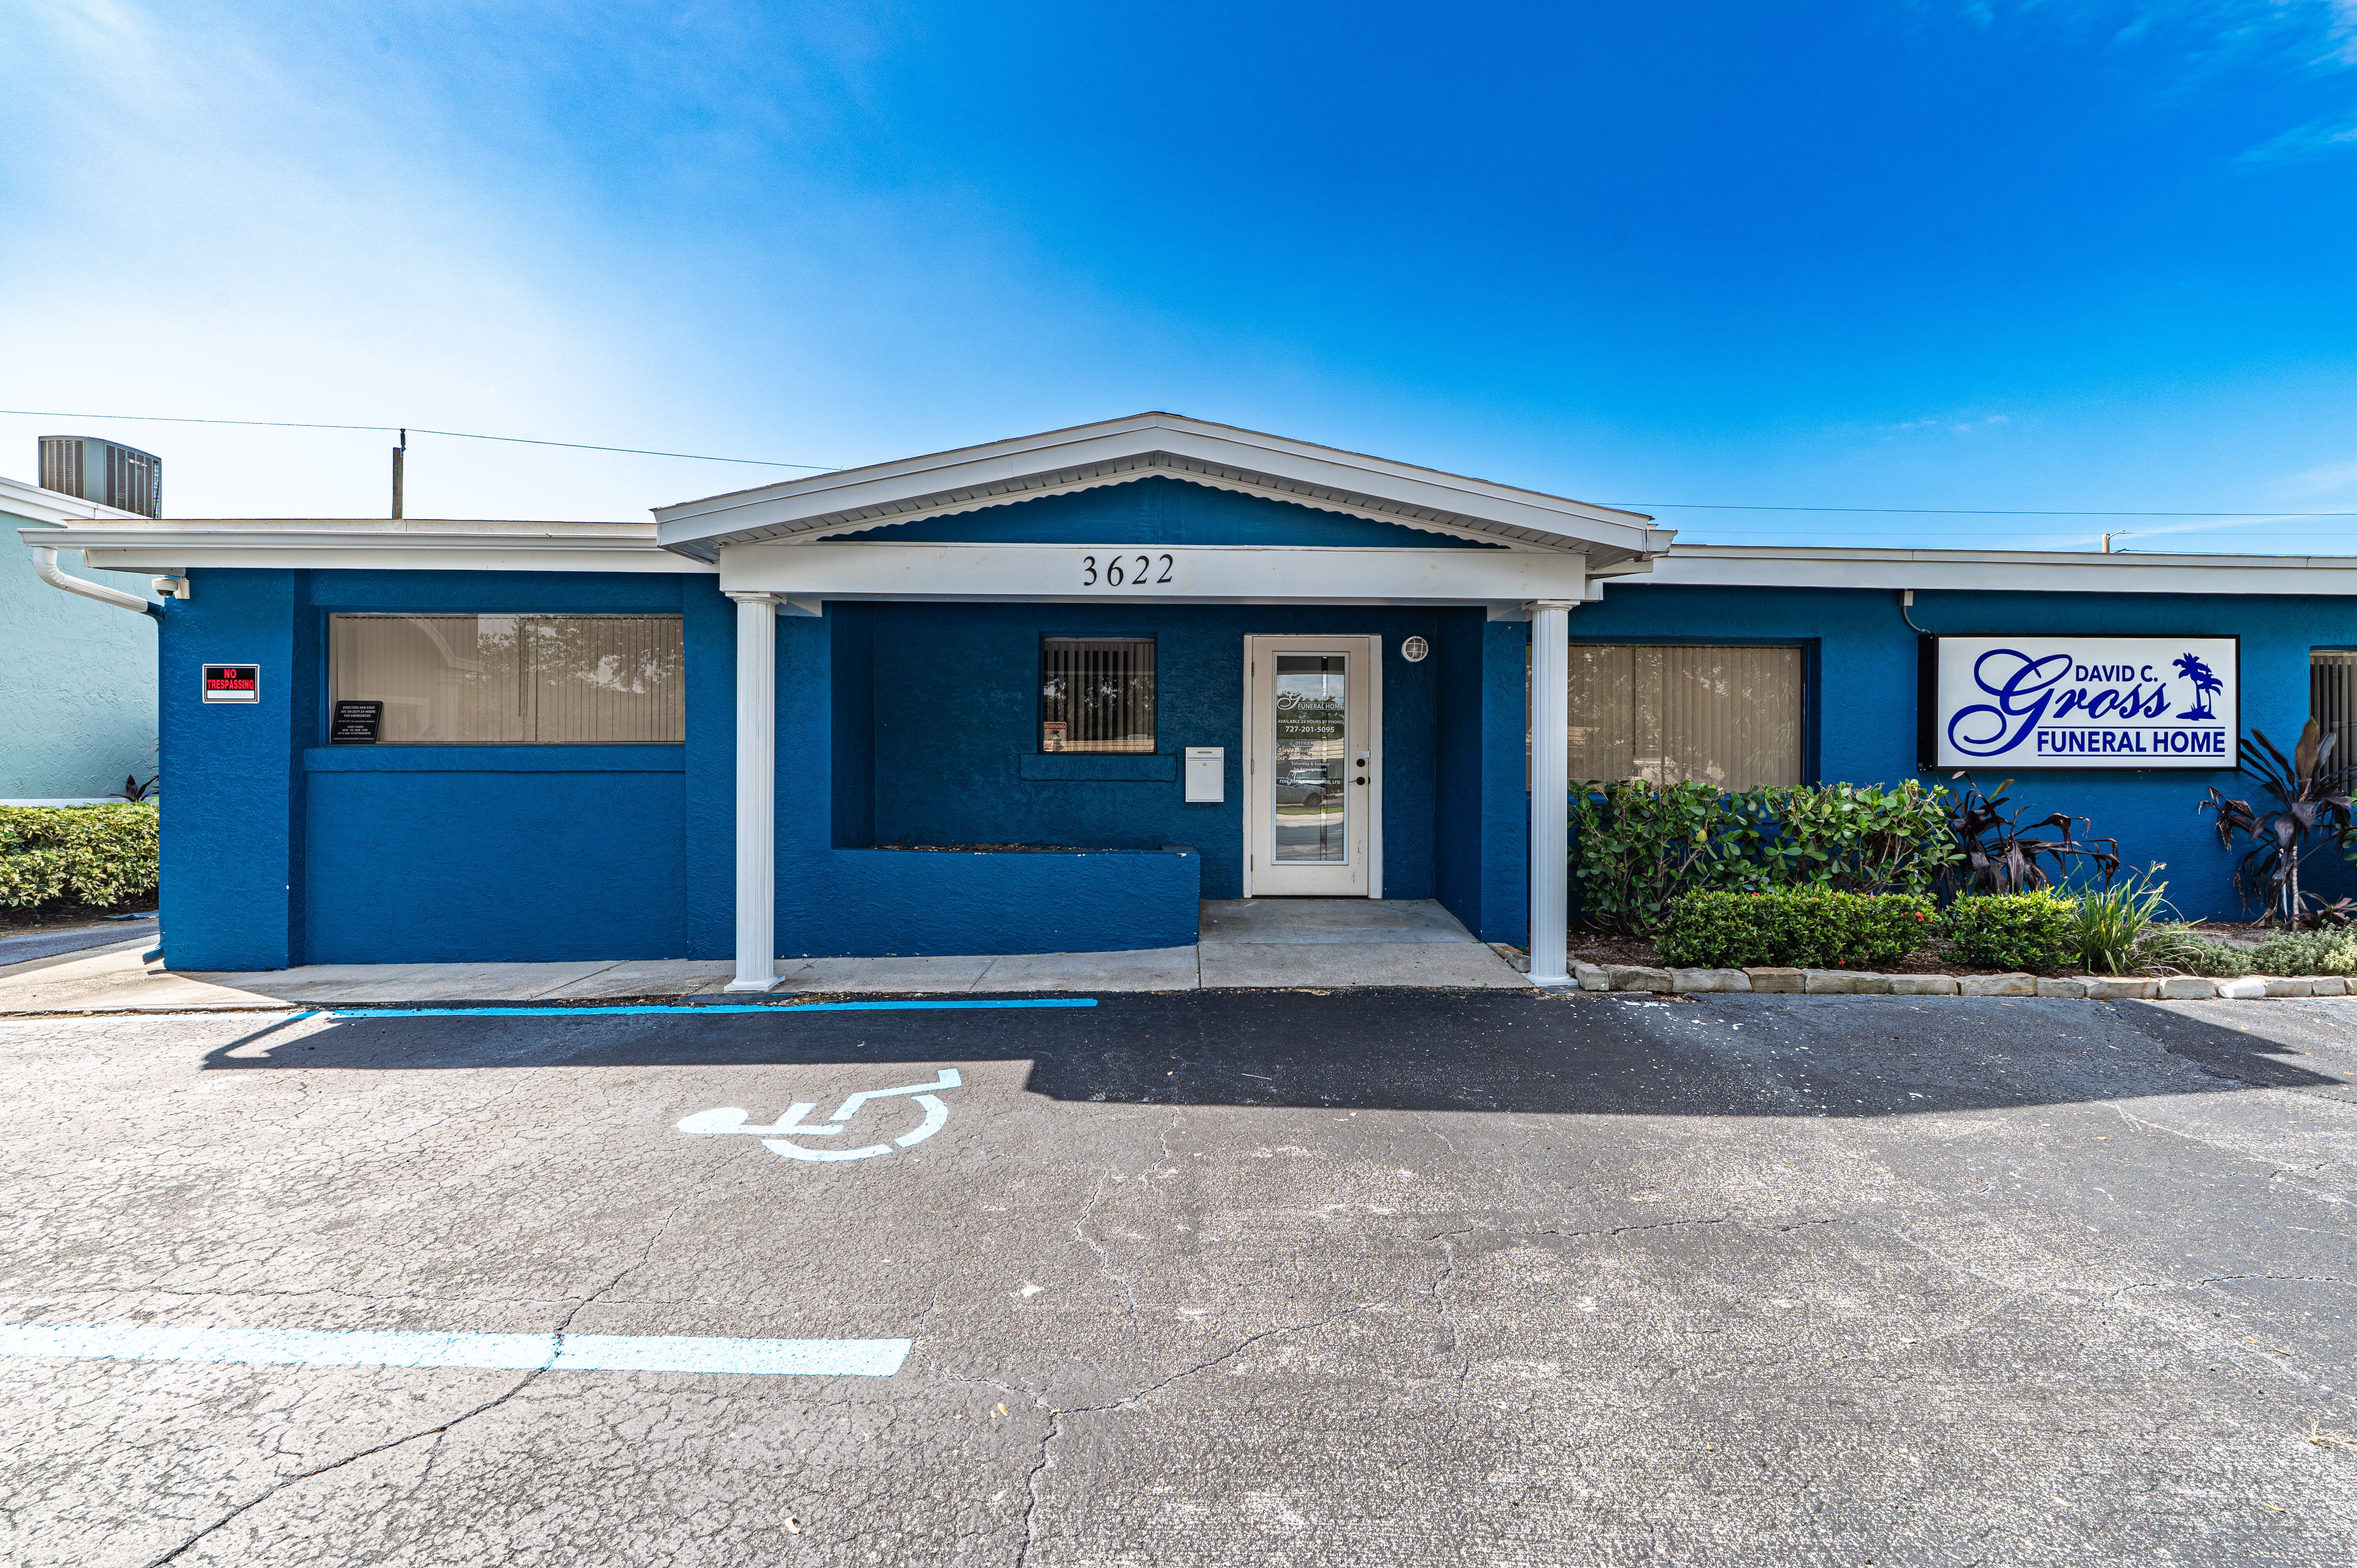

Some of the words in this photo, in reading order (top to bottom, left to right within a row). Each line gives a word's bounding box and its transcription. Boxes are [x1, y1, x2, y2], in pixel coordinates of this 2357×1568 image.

[1084, 554, 1173, 586] 3622
[224, 669, 237, 678] NO
[2076, 665, 2134, 682] DAVID
[2140, 665, 2158, 682] C.
[207, 679, 254, 689] TRESPASSING
[1948, 649, 2171, 757] Gross
[2038, 731, 2146, 752] FUNERAL
[2154, 731, 2225, 752] HOME
